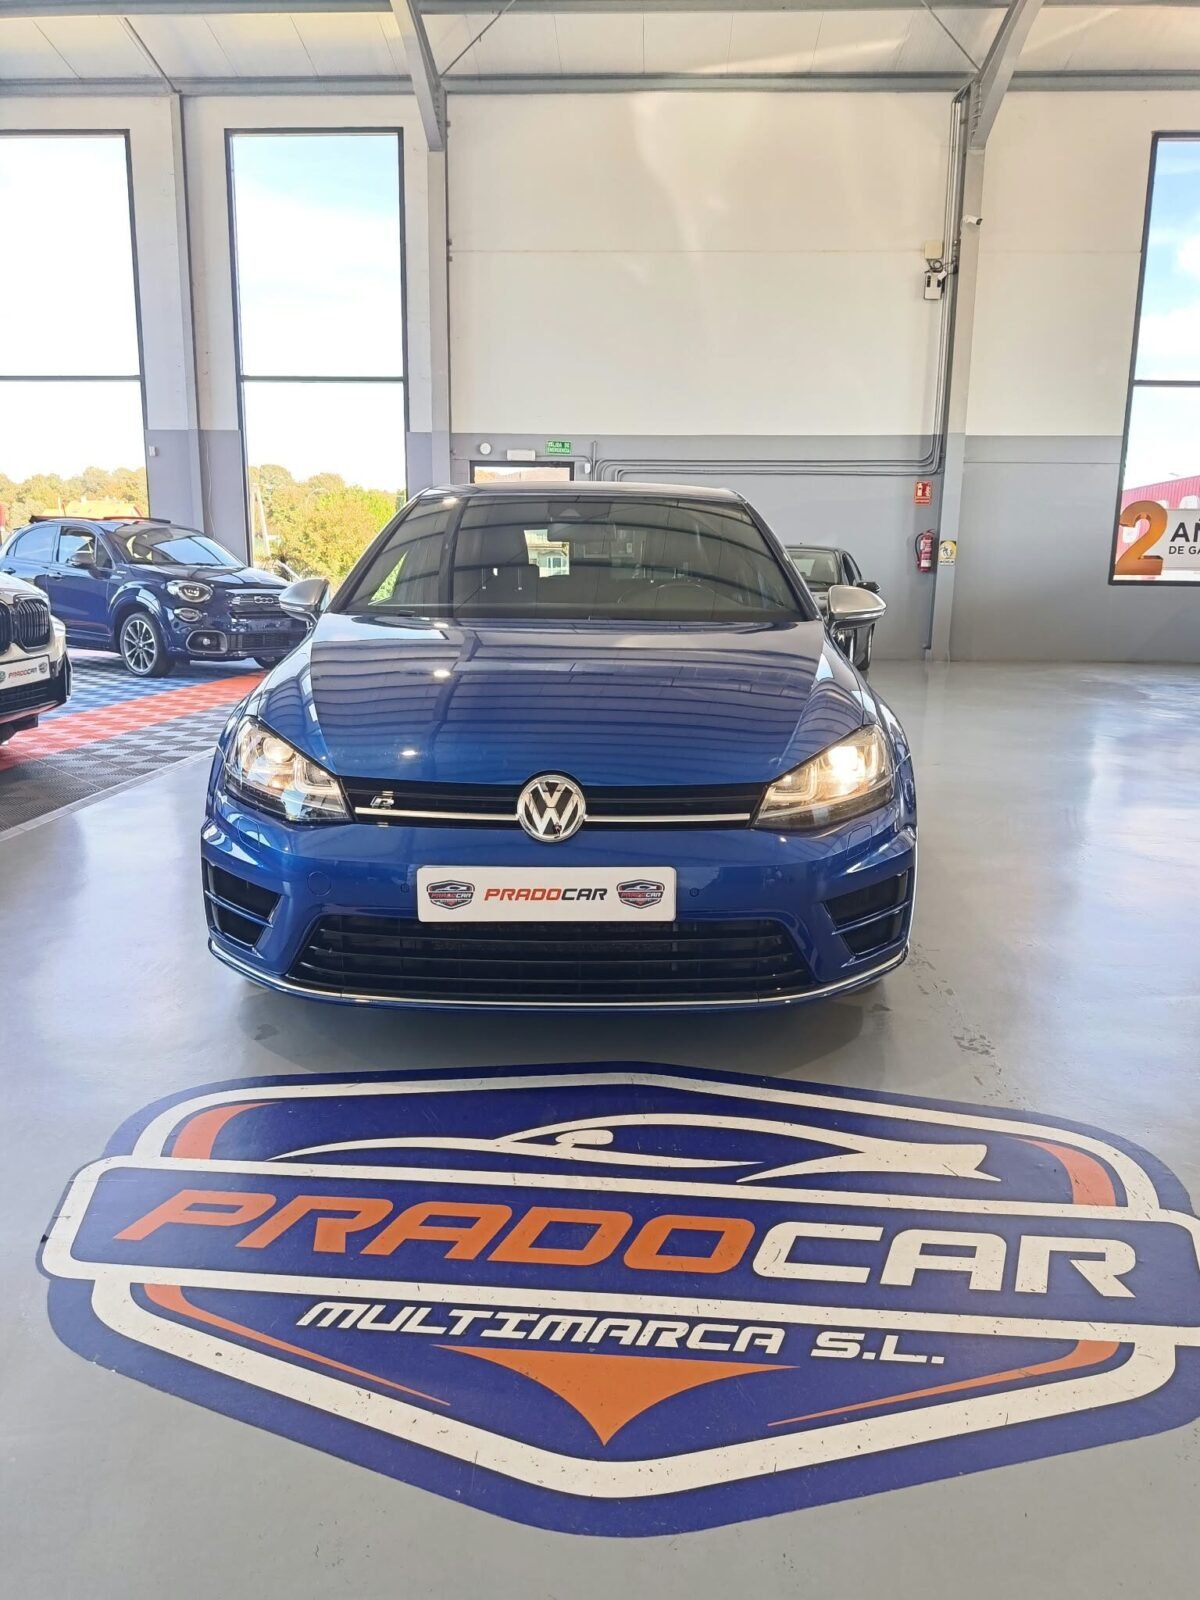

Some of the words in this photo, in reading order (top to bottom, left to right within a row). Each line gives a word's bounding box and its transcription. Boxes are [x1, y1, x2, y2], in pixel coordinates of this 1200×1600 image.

[1115, 500, 1168, 575] 2
[1169, 545, 1185, 555] DE
[1188, 545, 1200, 555] G
[484, 888, 608, 901] PRADOCAR
[113, 1188, 1137, 1298] PRADOCAR
[297, 1300, 786, 1355] MULTIMARCA
[810, 1331, 945, 1365] S.L.
